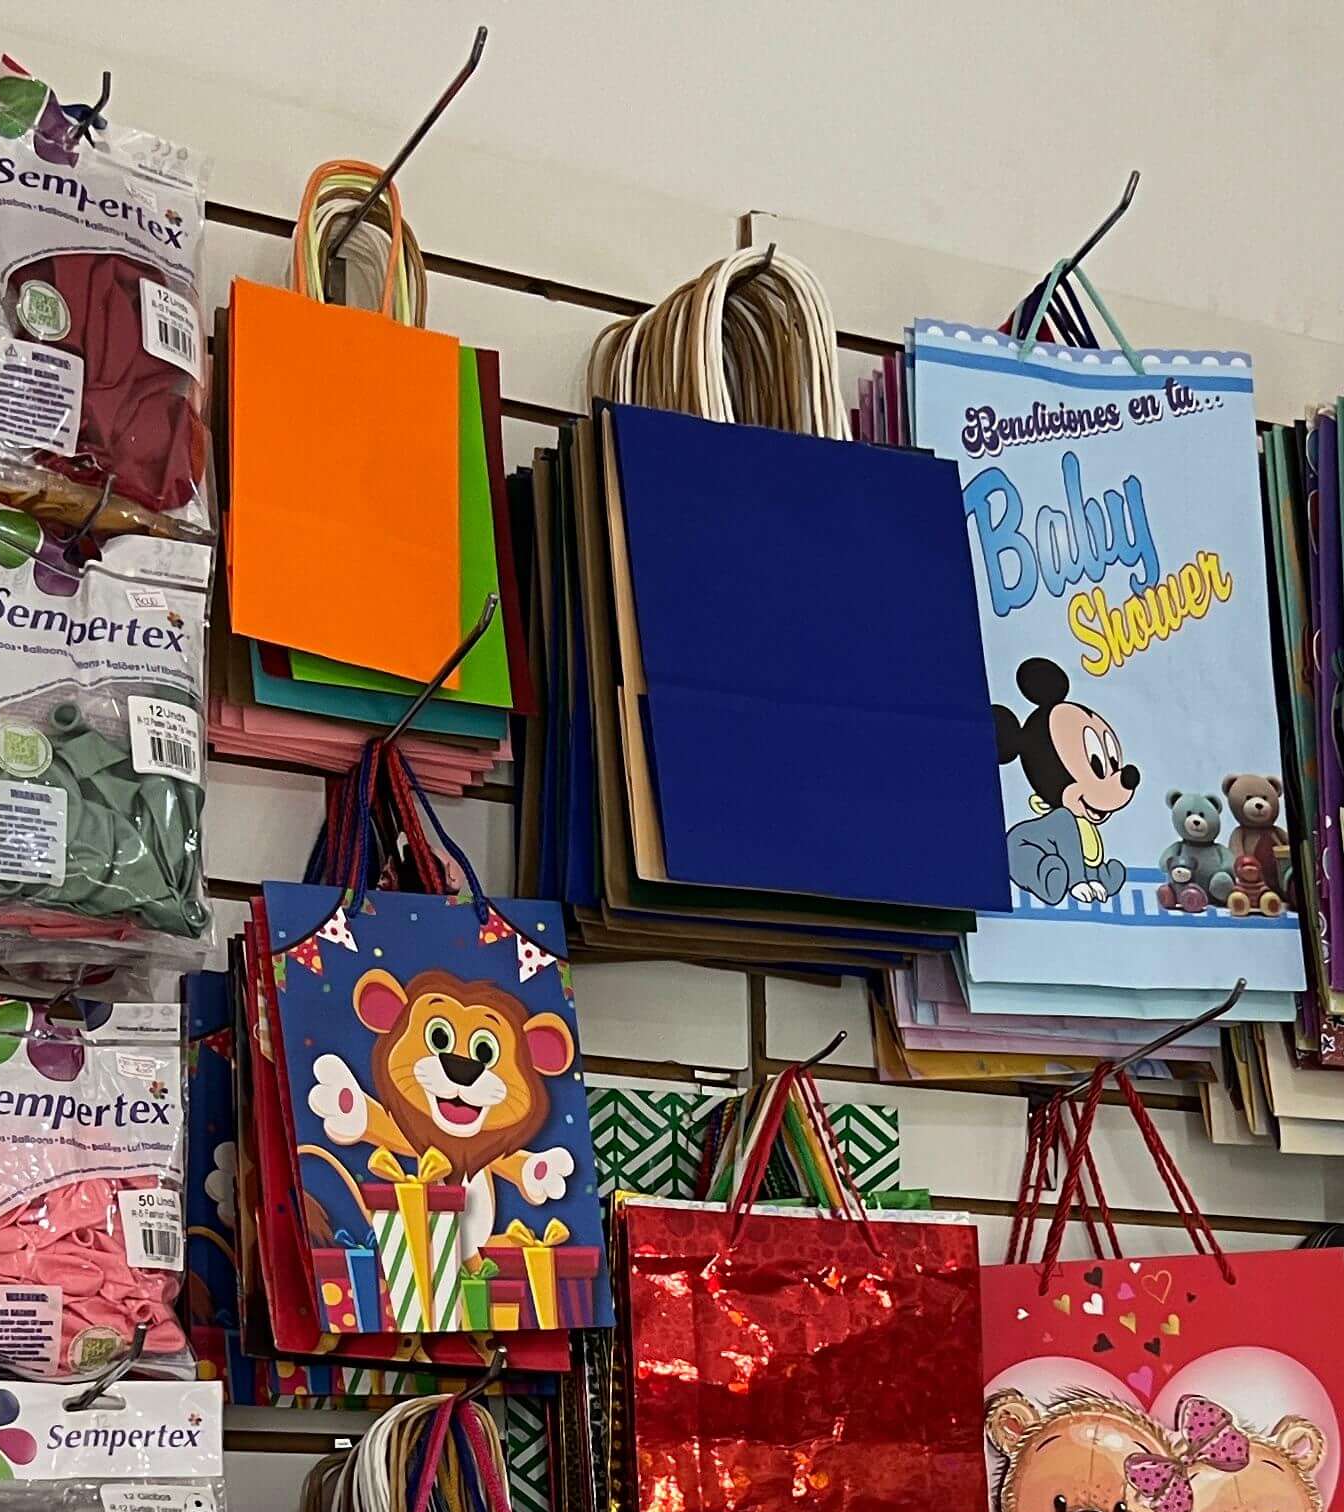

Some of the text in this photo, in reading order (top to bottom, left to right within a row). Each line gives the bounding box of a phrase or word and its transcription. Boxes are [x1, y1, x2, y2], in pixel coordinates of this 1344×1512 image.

[961, 391, 1160, 459] Bendiciones en
[962, 450, 1160, 618] Baby
[1068, 550, 1233, 678] Shower
[148, 704, 164, 719] 12
[138, 1195, 155, 1209] 50
[46, 1421, 204, 1458] Sempertex
